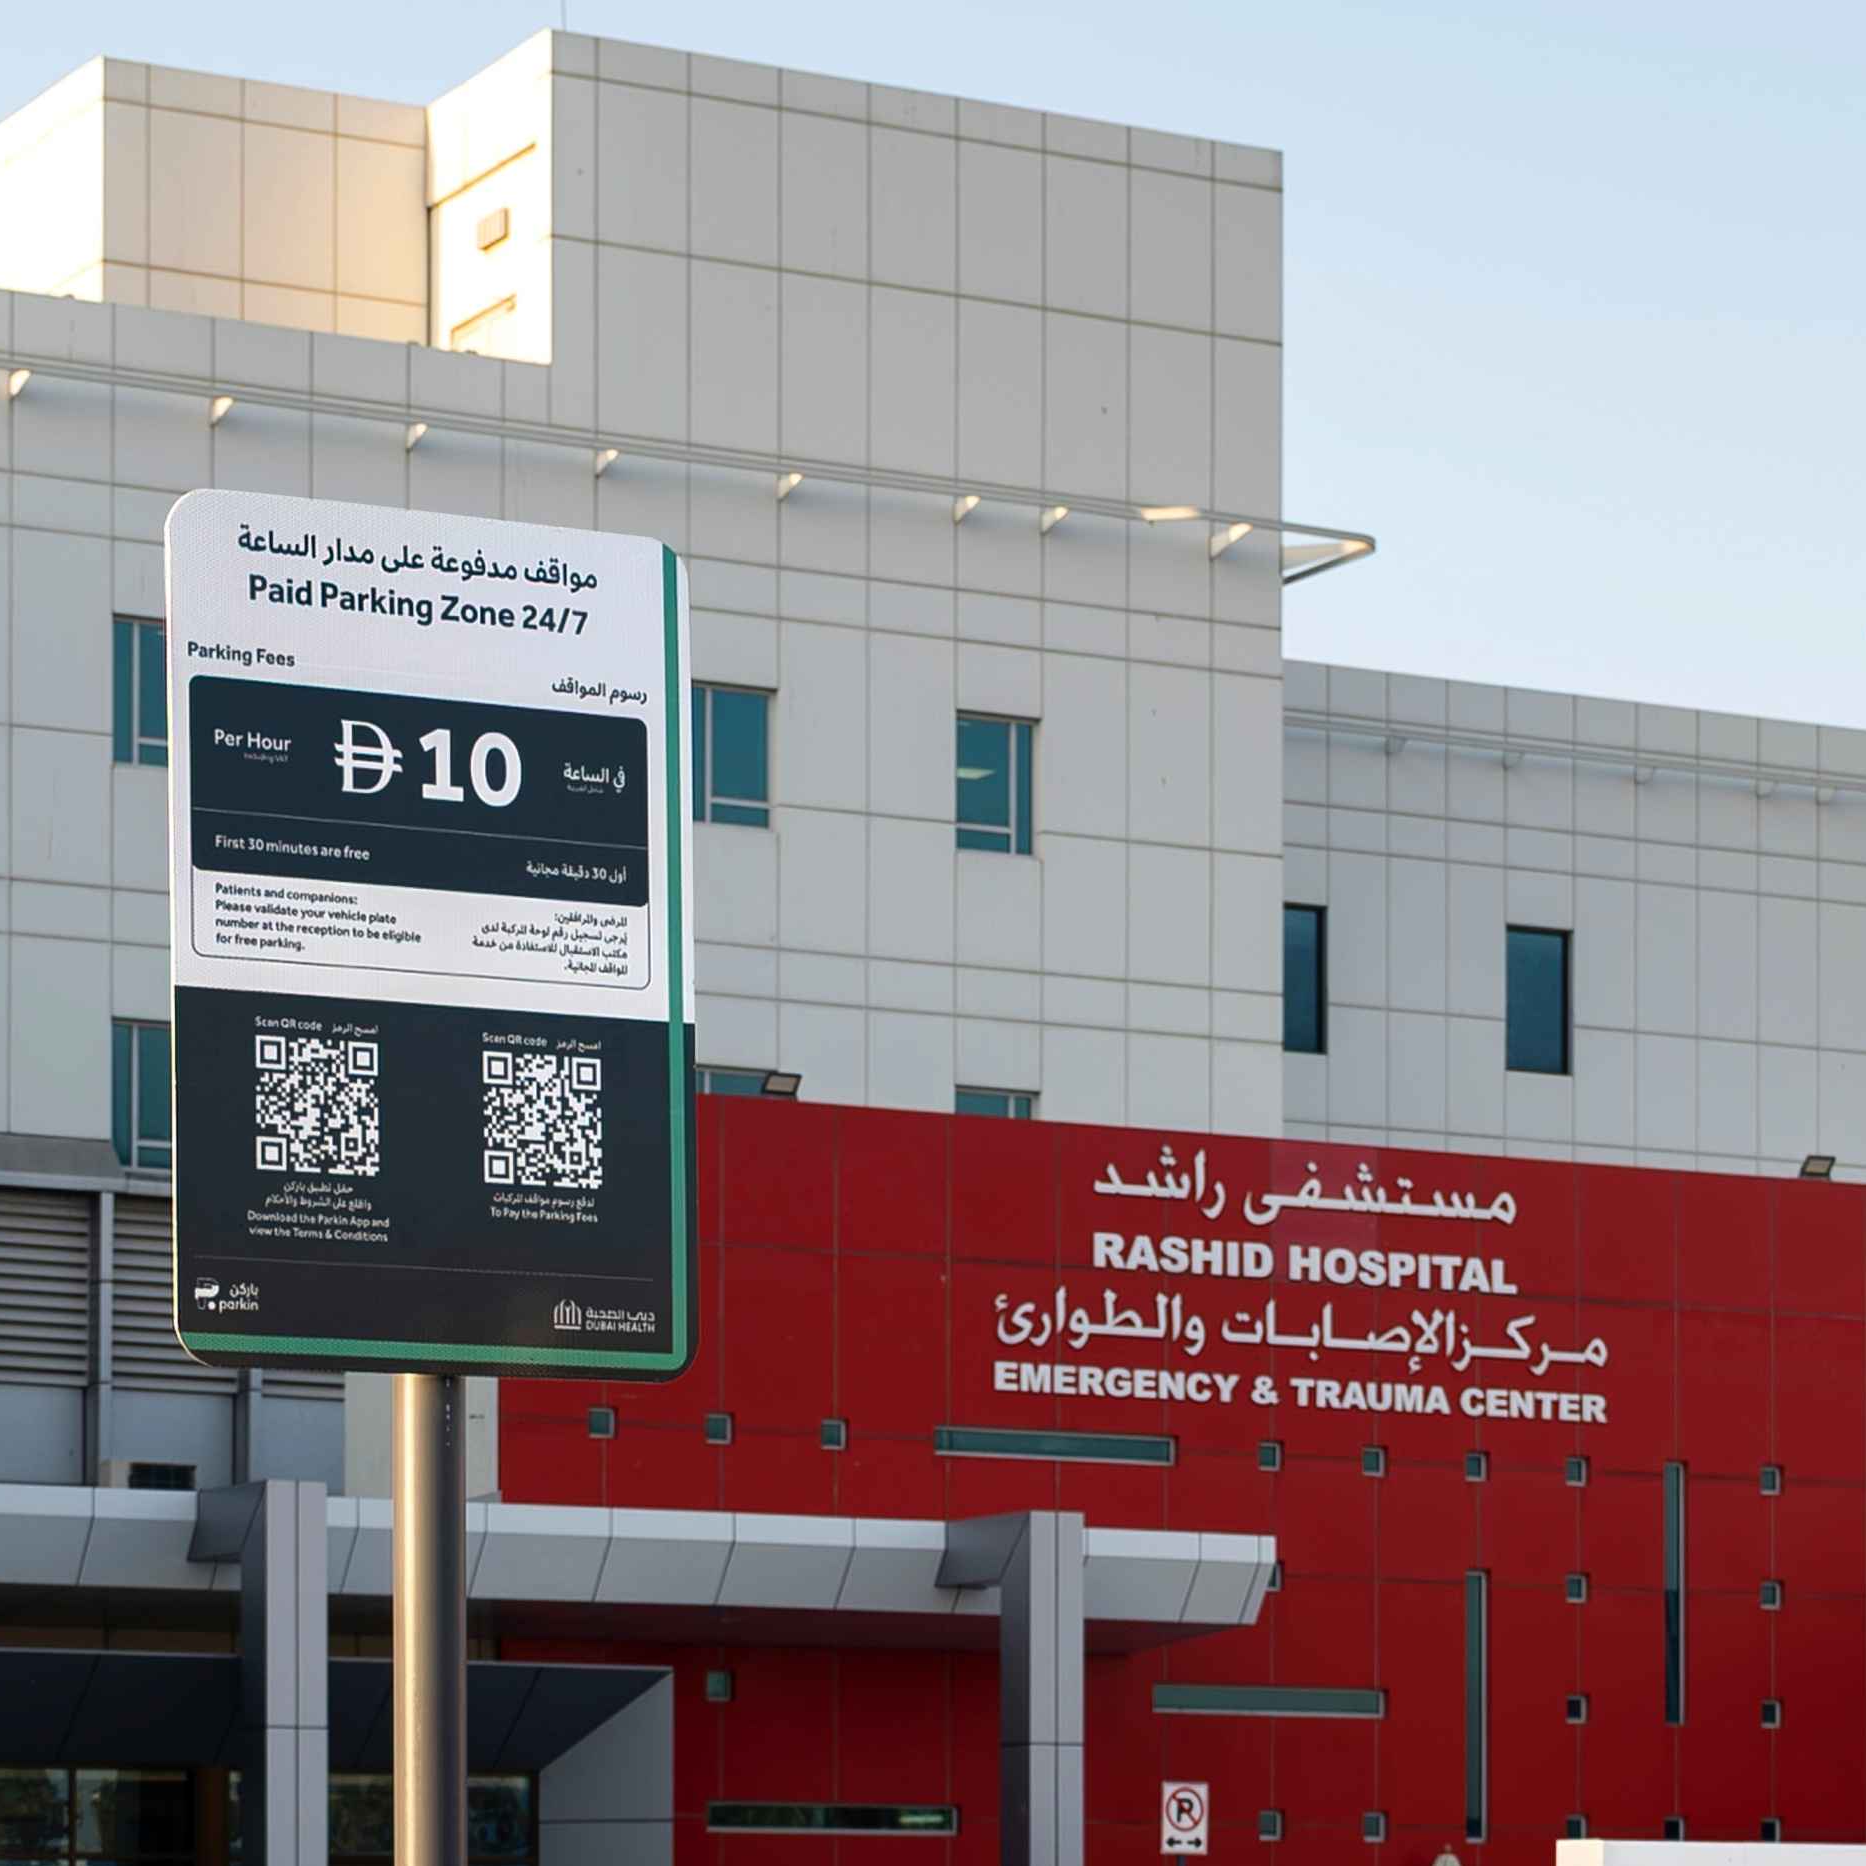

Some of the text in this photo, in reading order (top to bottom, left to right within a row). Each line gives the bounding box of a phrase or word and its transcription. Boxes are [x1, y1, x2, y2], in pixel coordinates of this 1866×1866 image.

[238, 524, 598, 593] مواقف مدفوعة على مدار الساعة
[248, 574, 589, 635] Paid Parking Zone 24/7
[187, 641, 295, 667] Parking Fees
[552, 677, 647, 705] رسوم المواقف
[214, 728, 292, 751] Per Hour
[418, 727, 523, 808] 10
[563, 762, 609, 783] الساعة
[613, 765, 626, 794] في
[215, 834, 370, 861] First 30 minutes are free
[591, 866, 607, 880] 30
[609, 866, 627, 884] أول
[215, 882, 358, 906] Patients and companions:
[215, 900, 397, 926] Please validate your vehicle plate
[215, 918, 421, 944] number at the reception to be eligible
[215, 933, 305, 952] for free parking.
[255, 1015, 323, 1031] Scan QR code
[482, 1031, 548, 1047] Scan QR code
[1093, 1143, 1518, 1226] مستشفى راشد
[247, 1209, 298, 1223] Download
[318, 1213, 348, 1226] Parkin
[349, 1216, 370, 1228] App
[334, 1229, 389, 1242] Conditions
[1092, 1232, 1519, 1295] RASHID HOSPITAL
[219, 1297, 259, 1314] parkin
[585, 1319, 655, 1333] DUBAI HEALTH
[994, 1285, 1205, 1356] والطوارئ
[994, 1361, 1608, 1424] EMERGENCY & TRAUMA CENTER
